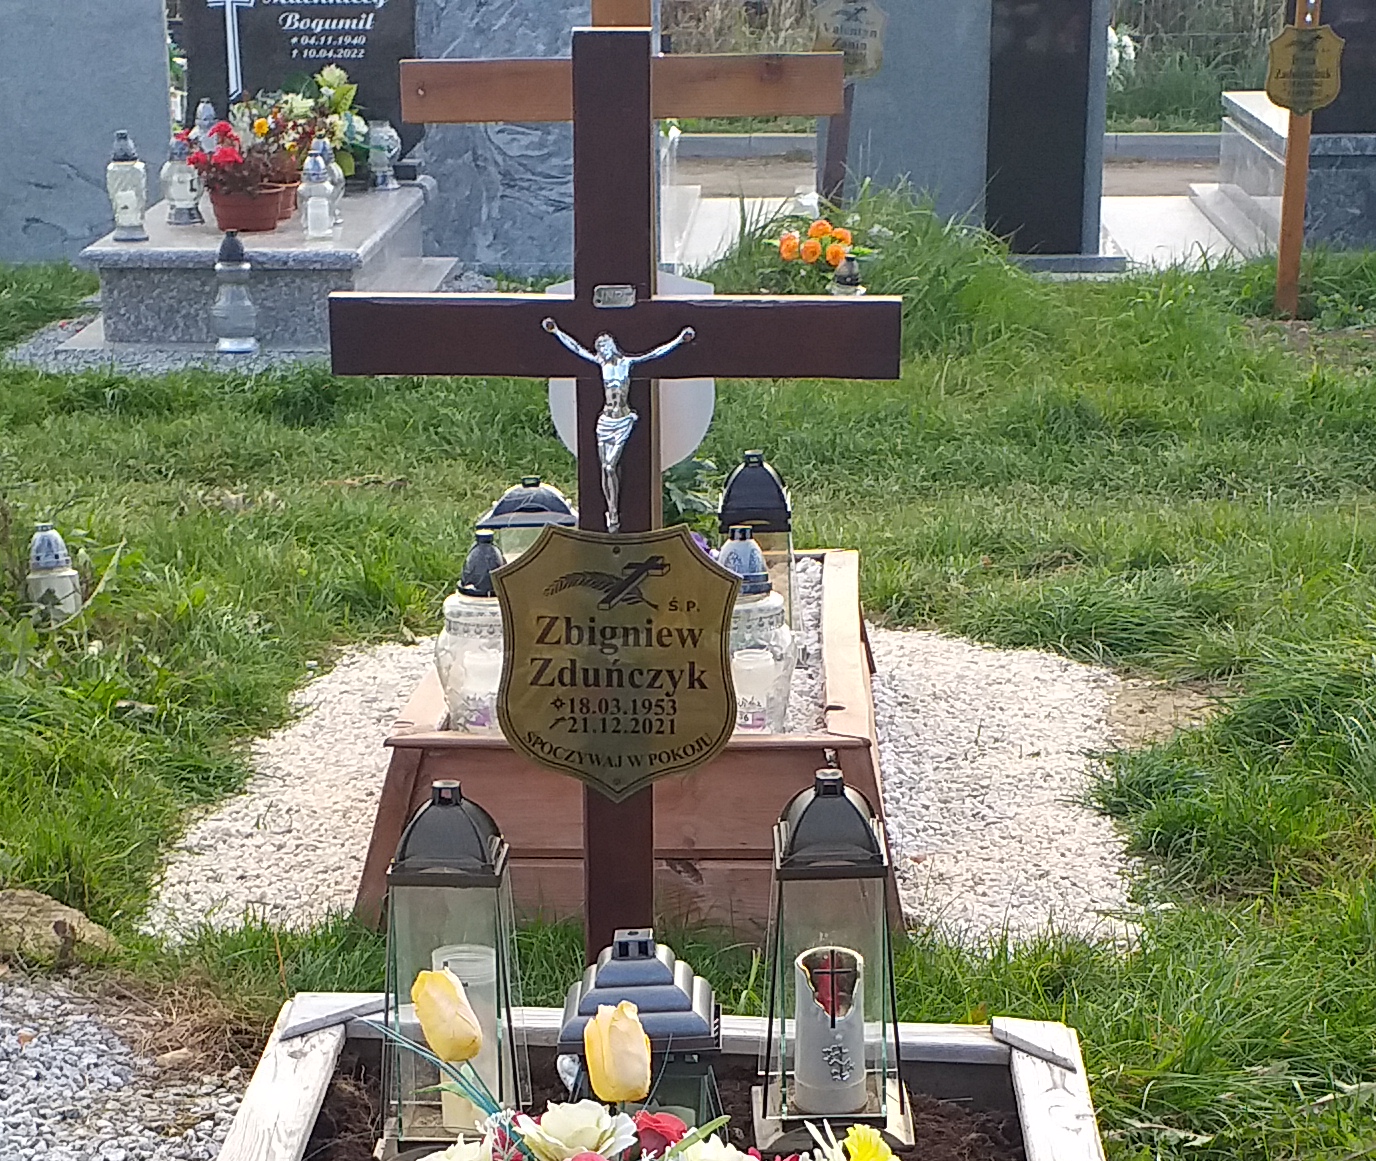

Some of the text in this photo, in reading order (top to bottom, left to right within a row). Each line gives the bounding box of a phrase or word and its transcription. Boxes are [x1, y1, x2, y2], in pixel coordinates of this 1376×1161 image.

[535, 615, 704, 655] Zbigniew
[528, 657, 709, 697] Zduńczyk
[567, 697, 678, 716] 18.03.1953
[566, 716, 677, 735] 21.12.2021
[525, 731, 713, 768] SPOCZYWAJ W POKOJU
